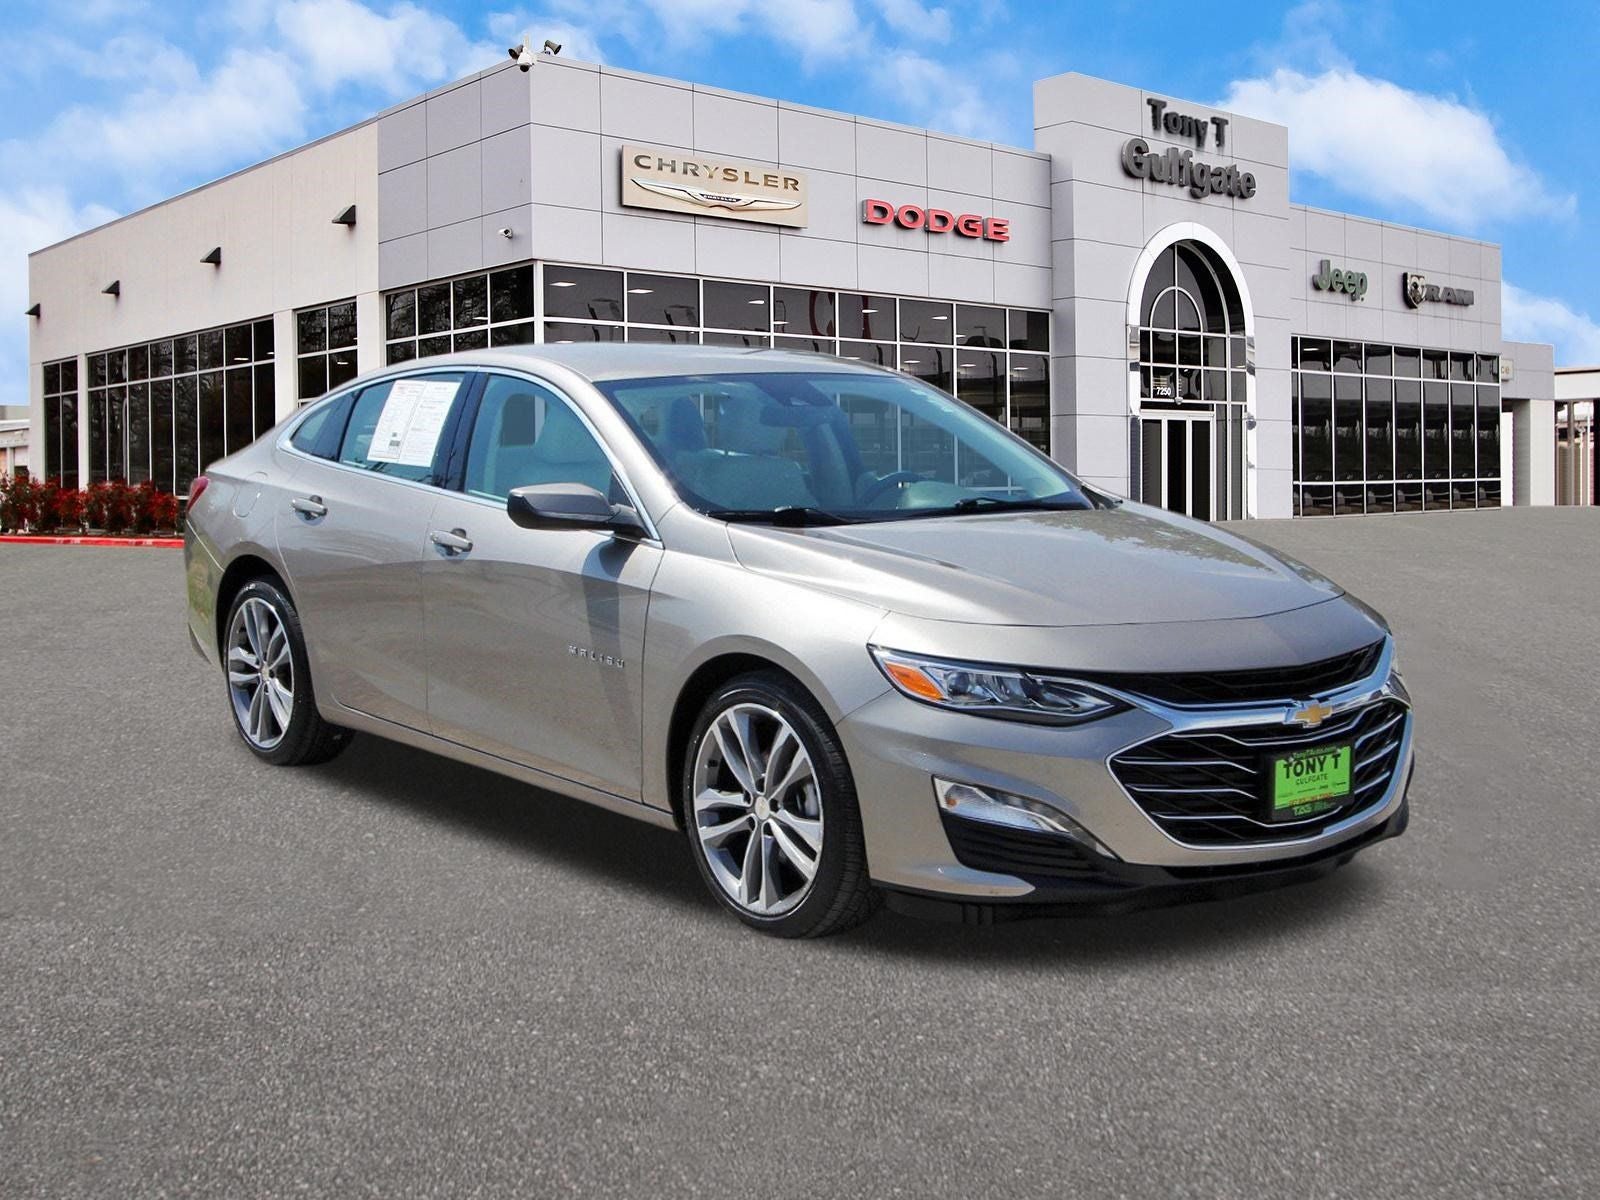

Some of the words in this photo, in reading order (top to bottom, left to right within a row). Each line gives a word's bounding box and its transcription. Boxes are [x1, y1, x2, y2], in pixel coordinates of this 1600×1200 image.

[1147, 98, 1208, 147] Tony
[1211, 117, 1229, 147] T
[634, 154, 800, 192] CHRYSLER
[1121, 138, 1256, 199] Gulfgate
[863, 198, 1010, 243] DODGE
[1313, 260, 1368, 301] Jeep
[1425, 284, 1475, 306] RAM
[1156, 387, 1171, 396] 7250
[1283, 756, 1327, 779] TONY
[1332, 754, 1341, 769] T
